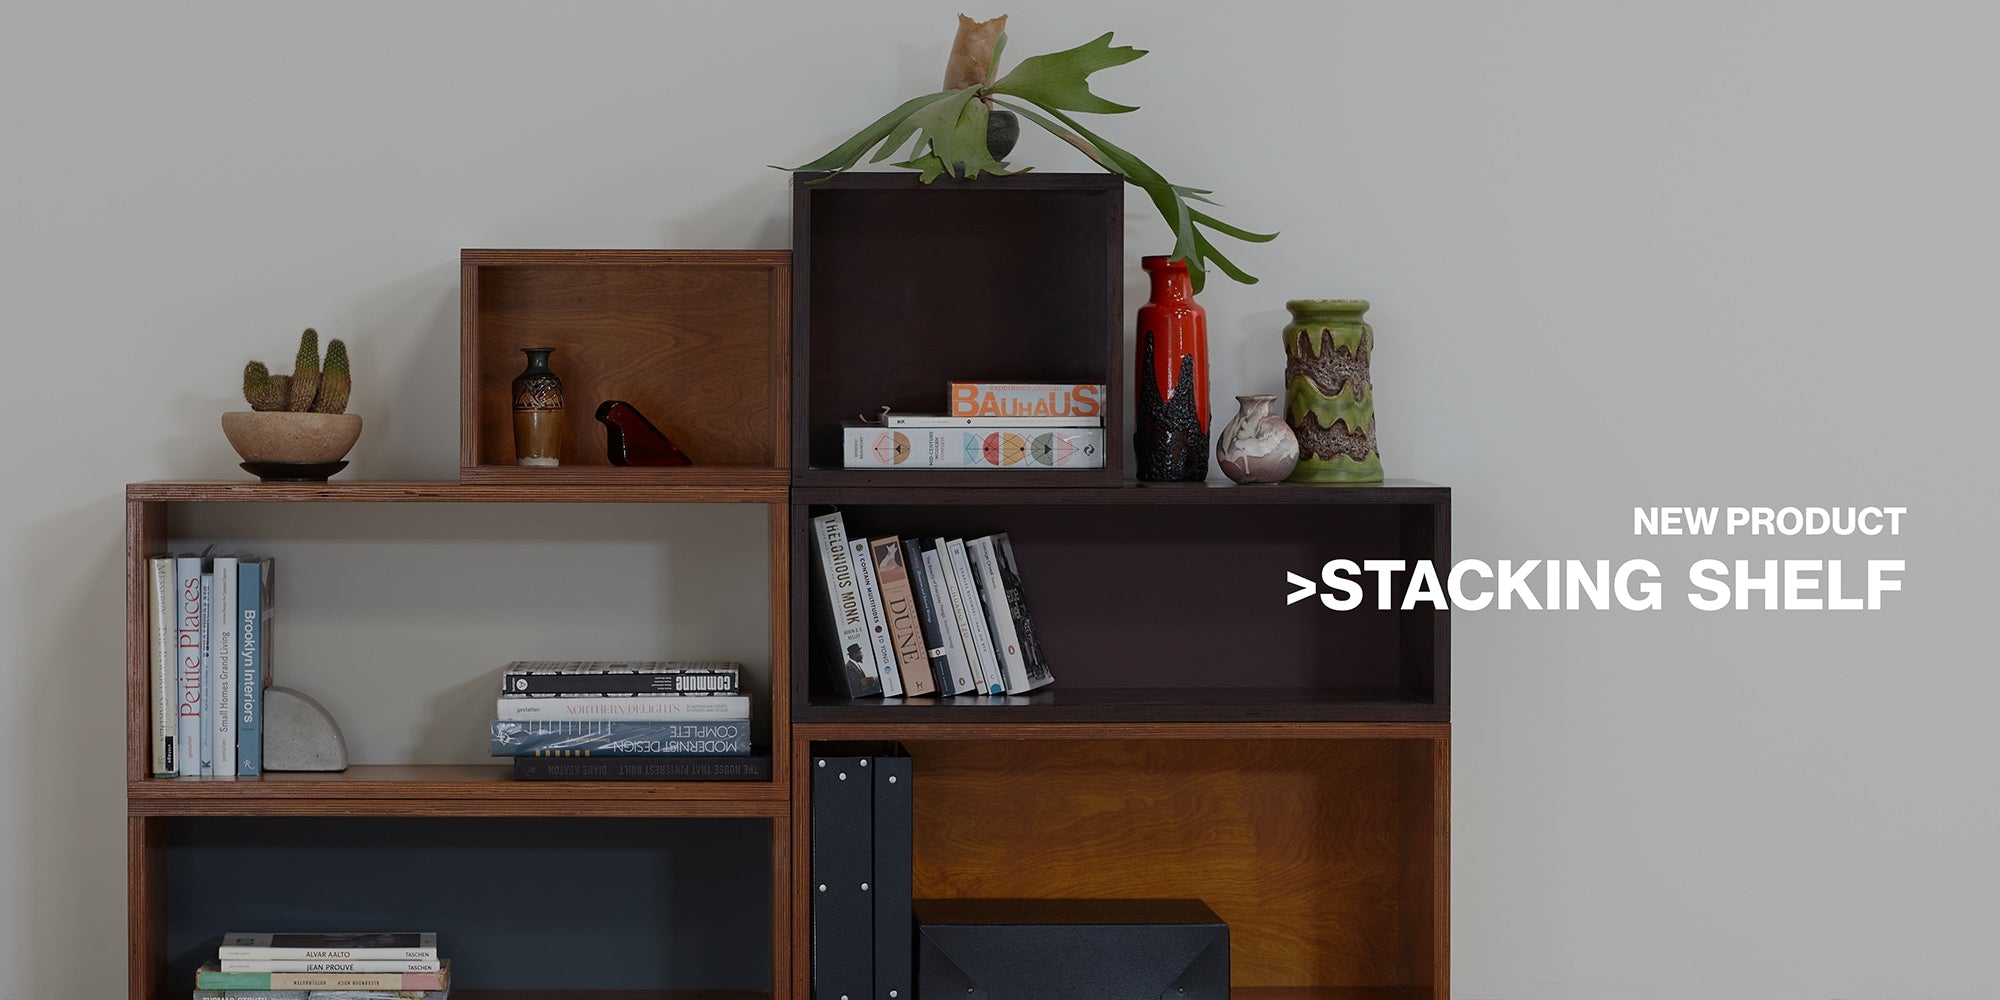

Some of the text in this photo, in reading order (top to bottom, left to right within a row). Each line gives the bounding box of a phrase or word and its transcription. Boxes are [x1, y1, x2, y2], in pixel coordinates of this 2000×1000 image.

[981, 542, 990, 560] George
[825, 518, 851, 588] THELONIOUS
[842, 592, 859, 624] MONK
[960, 568, 968, 589] CHARLES
[927, 565, 935, 580] Beauty
[933, 585, 942, 604] Everyday
[179, 578, 200, 649] Places
[860, 558, 870, 585] CONTAIN
[867, 588, 879, 623] MULTITUDES
[880, 645, 888, 664] YONG
[950, 587, 963, 620] CHUANG
[220, 632, 230, 654] Living
[890, 598, 920, 664] DUNE
[220, 656, 228, 680] Grand
[242, 610, 256, 723] Brooklyn Interiors
[179, 657, 200, 717] Petite
[675, 675, 731, 691] commune
[220, 682, 228, 709] Homes
[220, 710, 228, 732] Small
[516, 704, 680, 715] gestalten NORTHERN DELIGHTS
[670, 725, 738, 737] COMPLETE
[613, 740, 737, 753] MODERNIST DESIGN
[548, 765, 759, 775] THE HOUSE THAT PINTEREST BUILT DIANE KEATON
